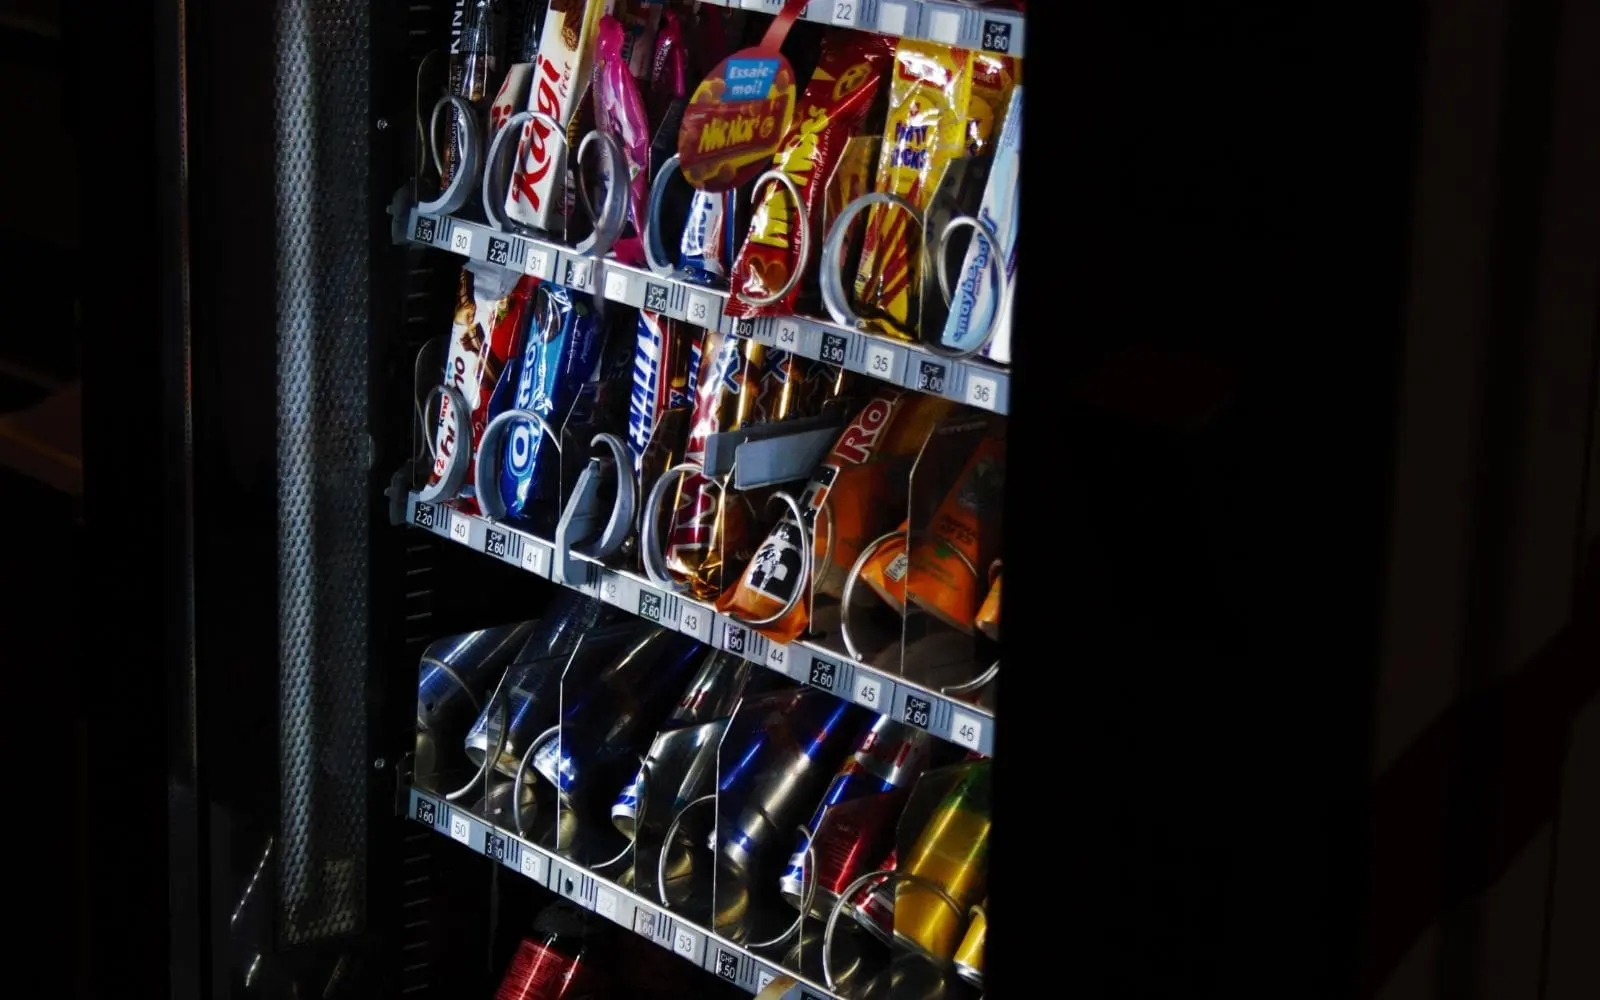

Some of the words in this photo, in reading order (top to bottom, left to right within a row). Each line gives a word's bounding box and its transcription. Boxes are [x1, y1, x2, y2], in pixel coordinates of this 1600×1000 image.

[836, 3, 852, 20] 22
[989, 22, 1007, 34] CHF
[984, 35, 1008, 51] 3.60
[731, 79, 763, 96] moi!
[420, 218, 433, 229] CHF
[416, 227, 433, 242] 3.50
[455, 235, 468, 249] 30
[493, 239, 507, 250] CHF
[489, 248, 508, 264] 2.20
[530, 258, 542, 271] 31
[651, 287, 665, 297] CHF
[647, 296, 667, 312] 2.20
[693, 303, 706, 319] 33
[780, 327, 796, 344] 34
[827, 334, 844, 348] CHF
[822, 345, 845, 363] 3.90
[872, 355, 888, 372] 35
[924, 360, 941, 374] CHF
[973, 384, 990, 402] 36
[420, 503, 432, 514] CHF
[415, 510, 433, 526] 2.20
[454, 523, 466, 538] 40
[491, 531, 503, 542] CHF
[488, 540, 504, 556] 2.60
[526, 551, 538, 567] 41
[644, 593, 659, 607] CHF
[640, 603, 660, 620] 2.60
[685, 615, 698, 631] 43
[770, 648, 784, 664] 44
[816, 660, 832, 674] CHF
[811, 669, 833, 688] 2.60
[861, 686, 875, 703] 45
[910, 698, 927, 711] CHF
[905, 707, 928, 726] 2.60
[959, 725, 975, 742] 46
[420, 800, 432, 811] CHF
[416, 807, 434, 825] 3.60
[454, 823, 466, 838] 50
[679, 934, 692, 953] 53
[720, 953, 735, 965] CHF
